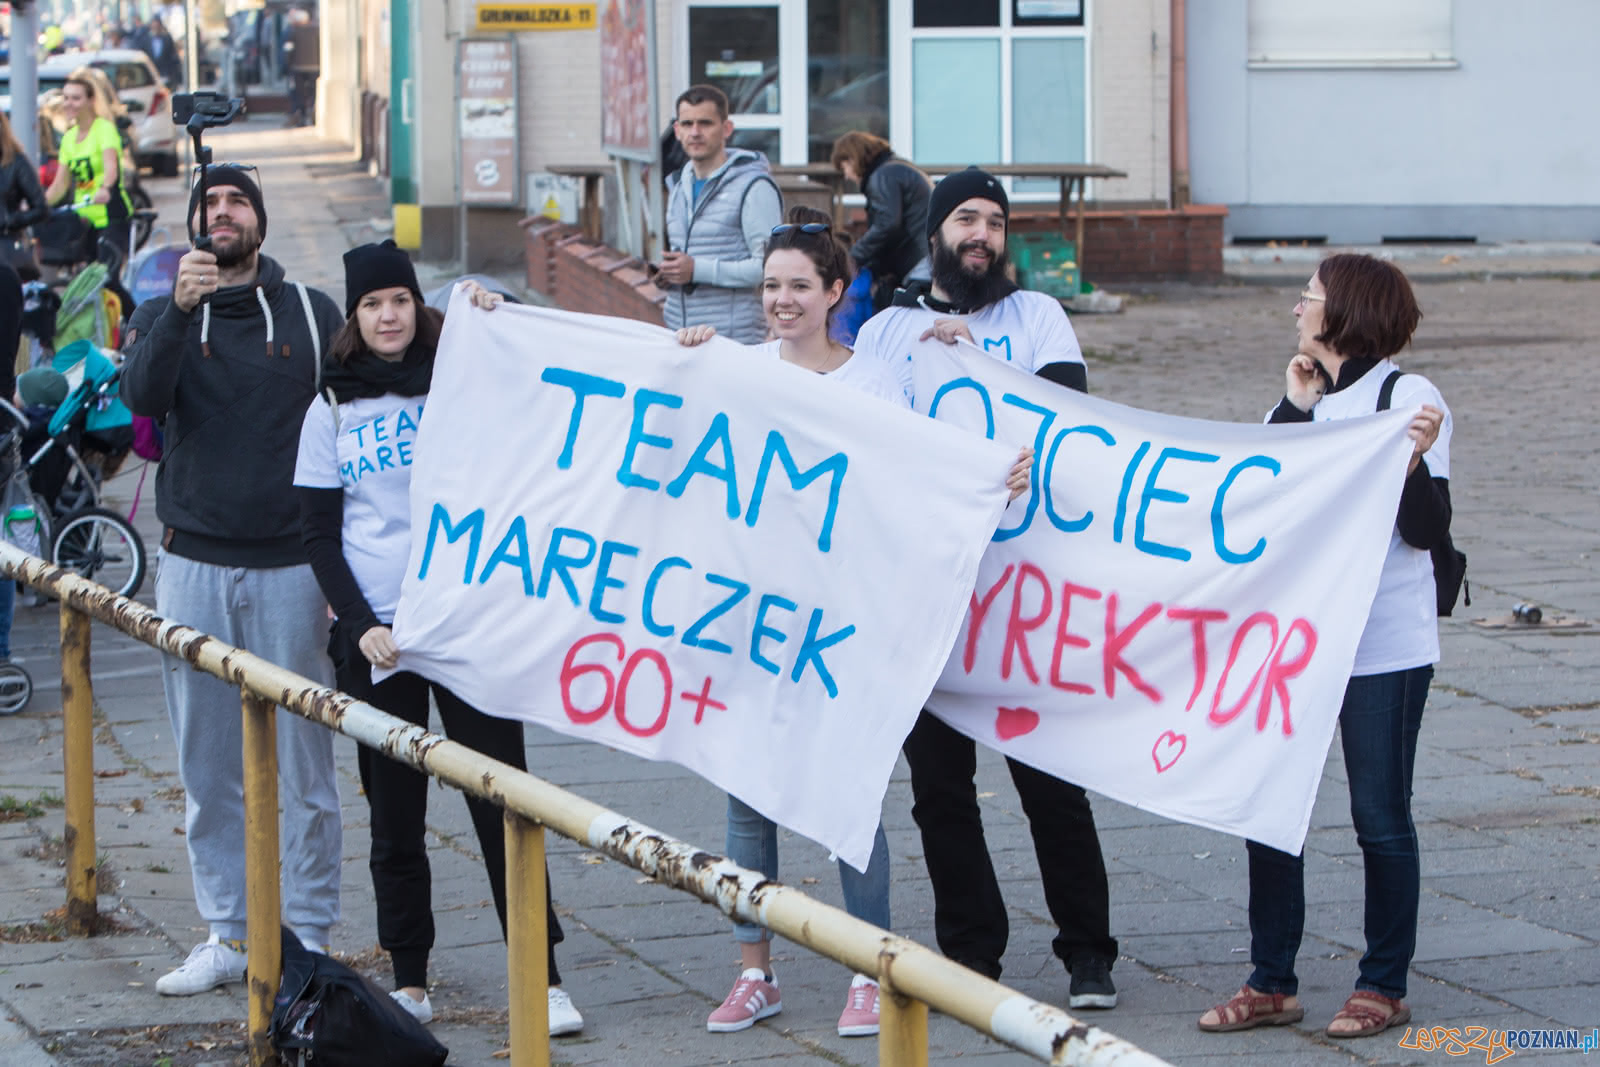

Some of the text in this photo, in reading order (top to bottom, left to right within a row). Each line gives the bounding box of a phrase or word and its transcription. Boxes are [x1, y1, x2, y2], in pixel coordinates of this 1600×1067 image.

[340, 440, 413, 484] MARE
[348, 404, 424, 449] TEA
[540, 367, 849, 553] TEAM
[418, 503, 857, 699] MARECZEK
[963, 562, 1319, 739] YREKTOR
[559, 632, 727, 738] 60+
